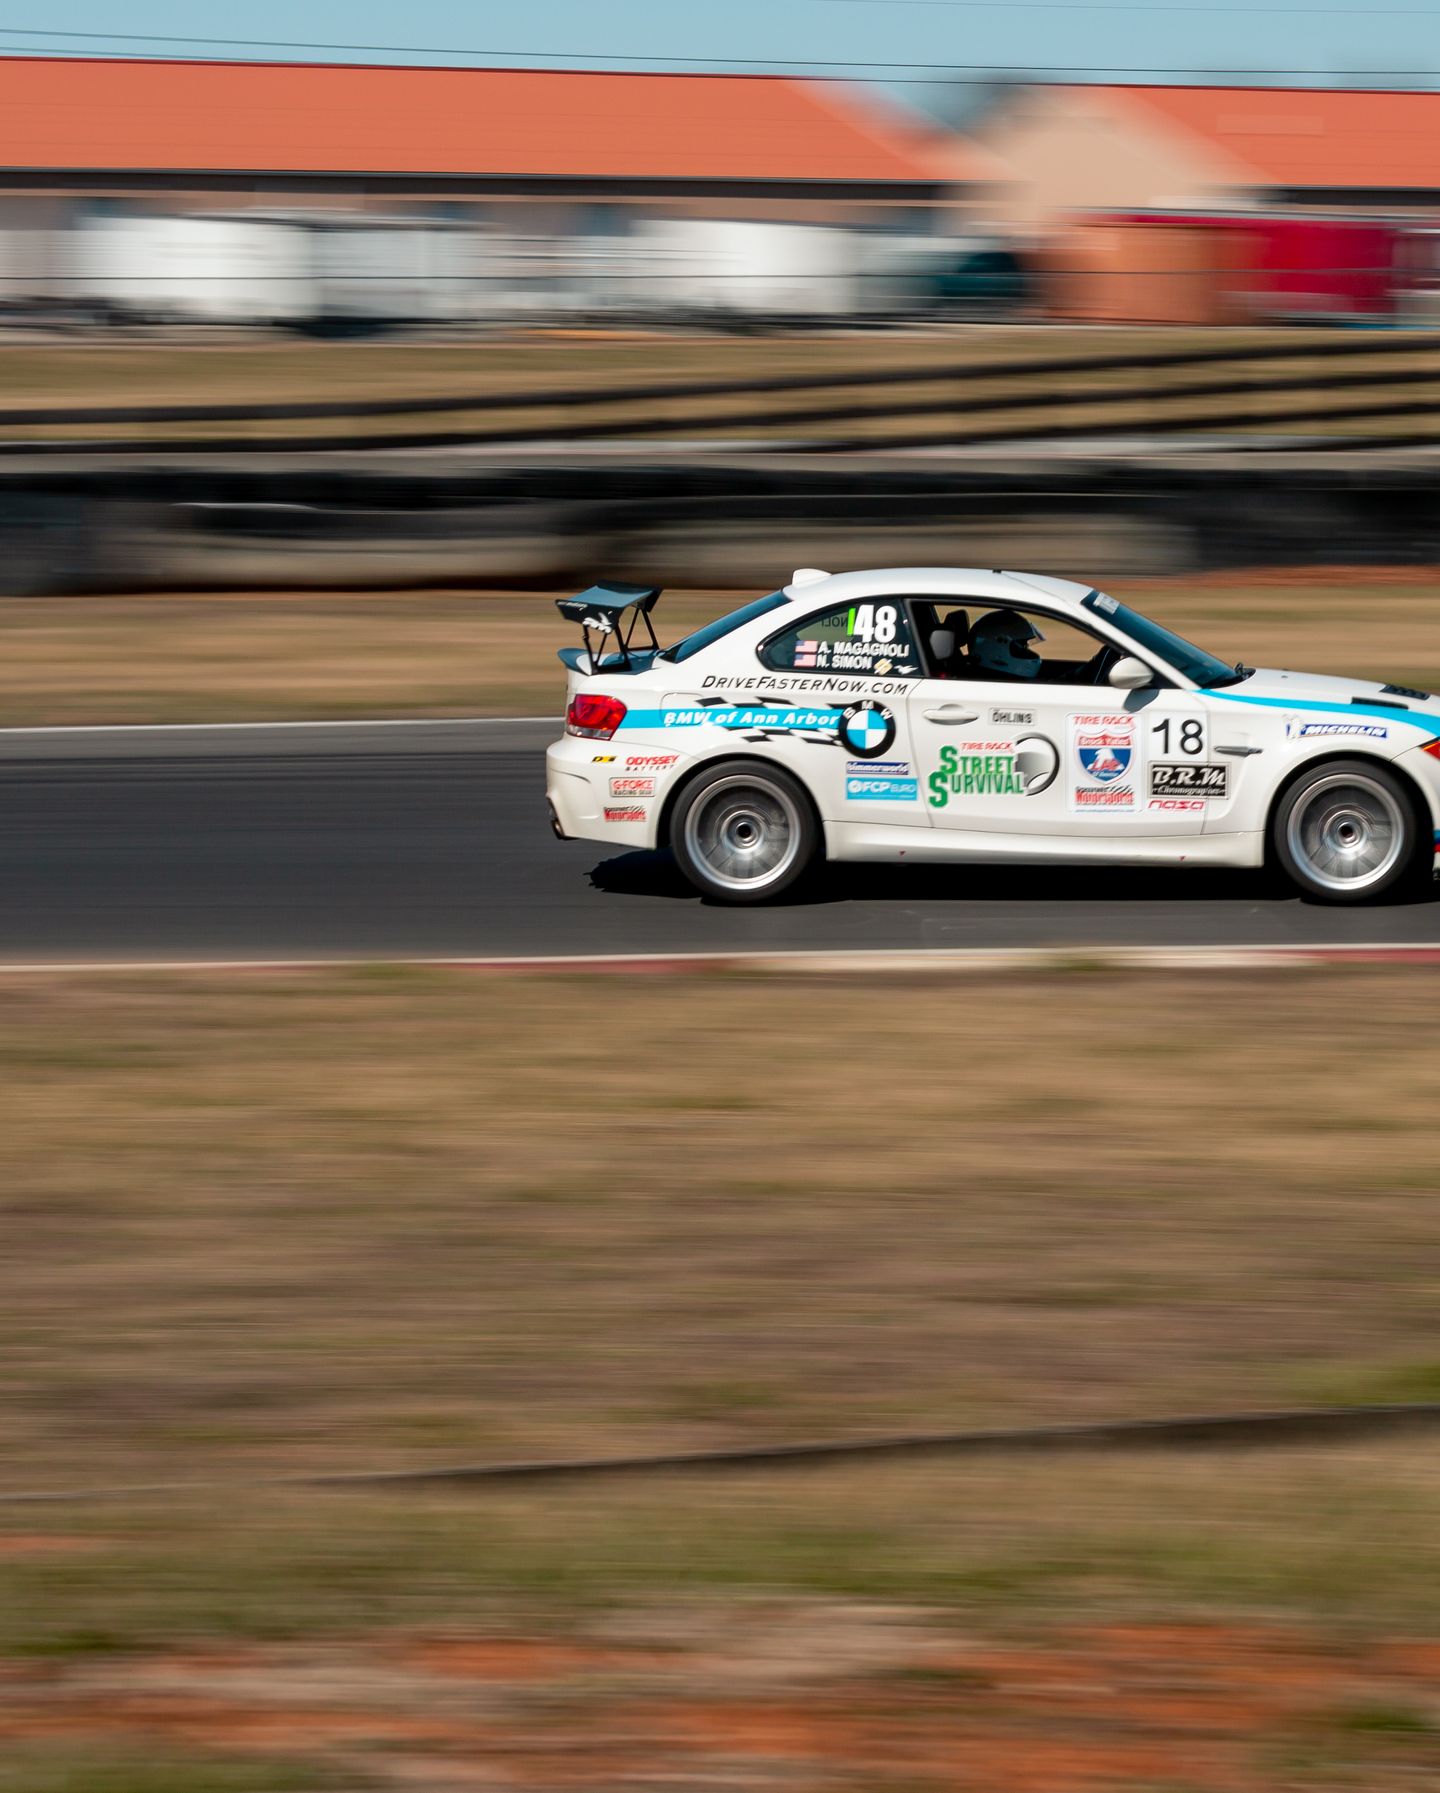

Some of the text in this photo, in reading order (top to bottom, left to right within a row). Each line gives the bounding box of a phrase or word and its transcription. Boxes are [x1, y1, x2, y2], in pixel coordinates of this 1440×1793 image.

[818, 641, 910, 657] A. MAGAGNOLI
[817, 654, 873, 670] N. SIMON
[842, 700, 893, 720] BMW
[664, 711, 840, 726] BMW of Ann Arbor
[1075, 715, 1134, 725] TIRE RACK
[1152, 718, 1203, 755] 18
[1304, 725, 1385, 737] MICHELIN
[961, 742, 1012, 751] TIRE RACK
[626, 755, 679, 766] ODYSSEY
[940, 746, 1014, 774] STREET
[861, 781, 890, 793] FCP
[928, 771, 1024, 808] SURVIVAL
